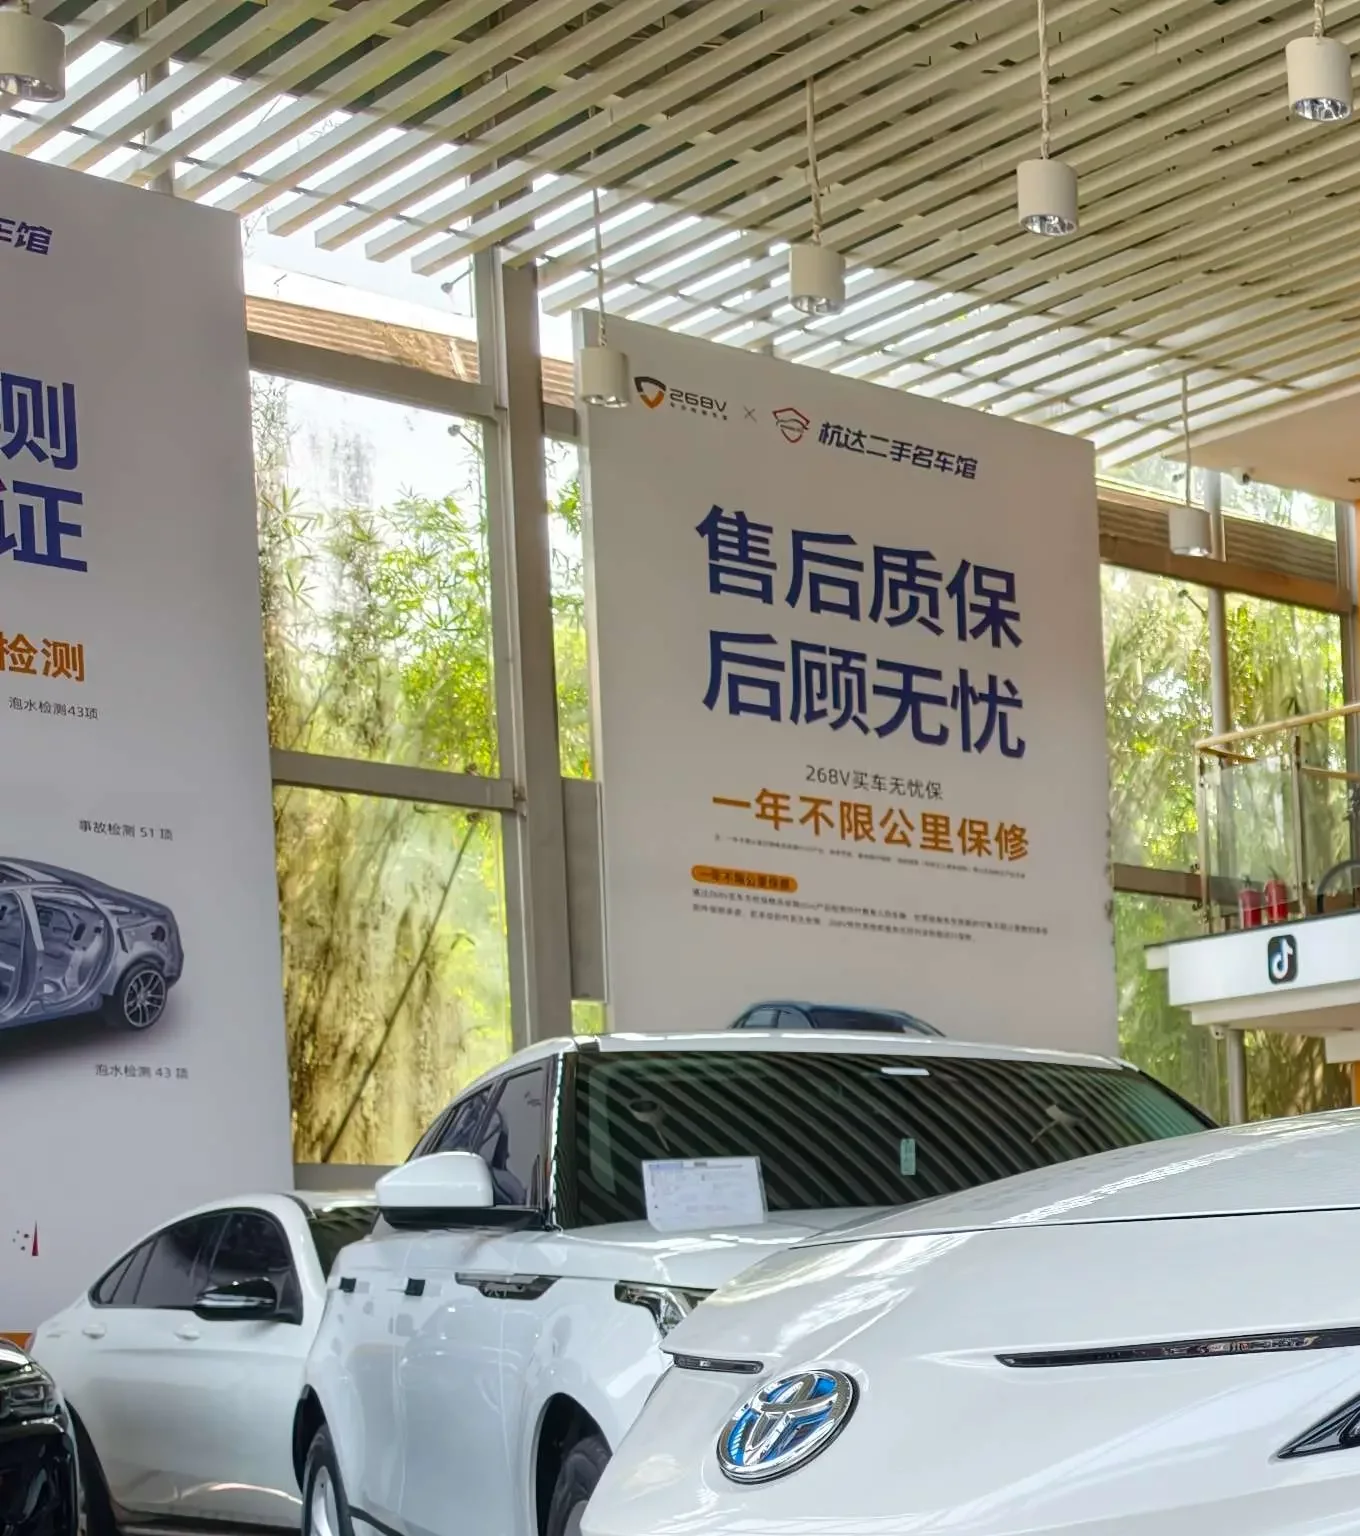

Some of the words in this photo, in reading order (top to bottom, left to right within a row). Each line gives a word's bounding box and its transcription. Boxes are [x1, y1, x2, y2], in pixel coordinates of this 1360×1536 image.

[818, 421, 978, 480] 杭达二手名车馆
[0, 477, 88, 573] 证
[695, 504, 1024, 649] 售后质保
[0, 631, 85, 682] 检测
[702, 629, 1026, 760] 后顾无忧
[805, 764, 943, 801] 268V买车无忧保
[712, 787, 1030, 863] 一年不限公里保修
